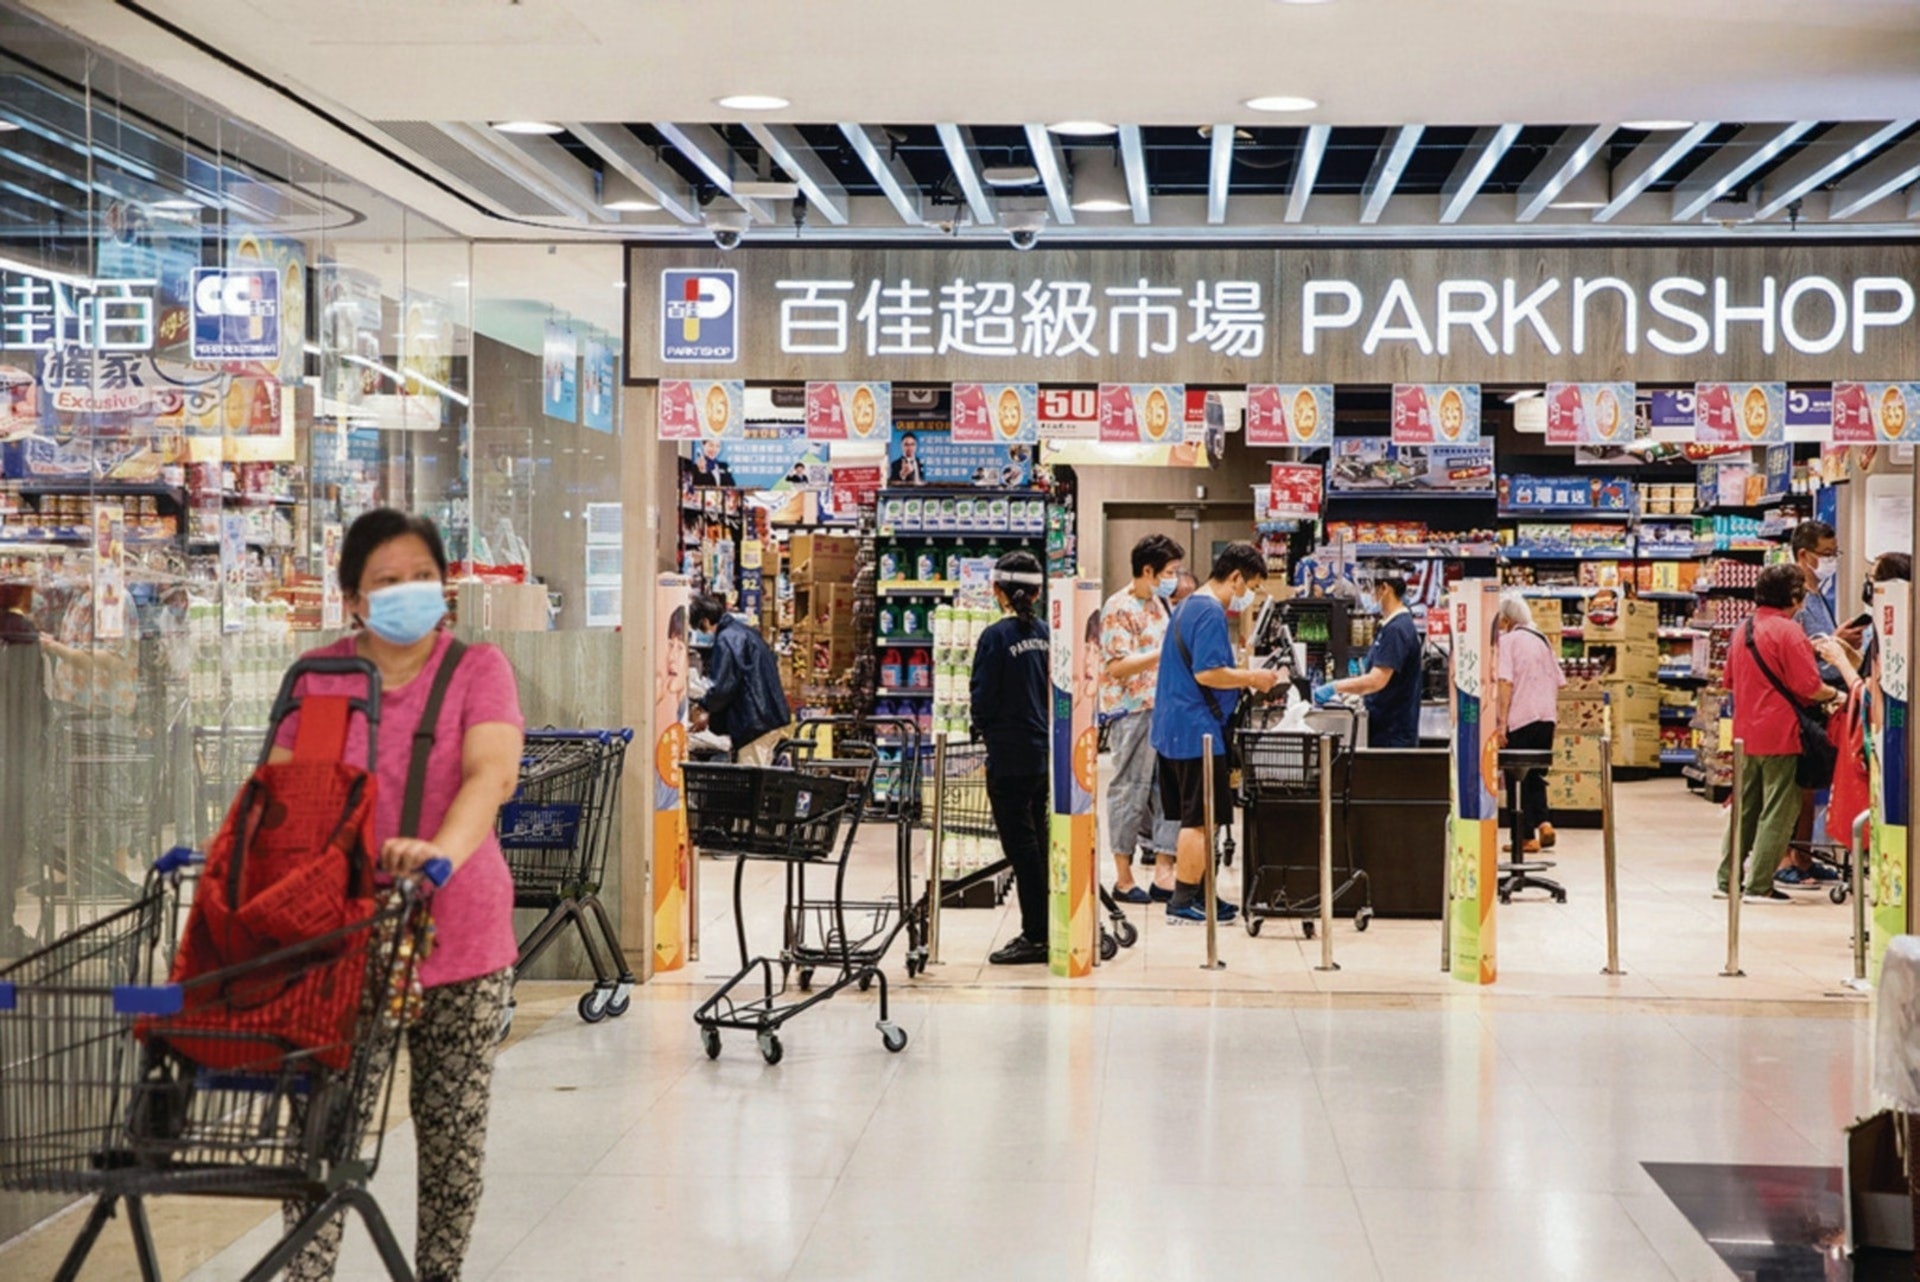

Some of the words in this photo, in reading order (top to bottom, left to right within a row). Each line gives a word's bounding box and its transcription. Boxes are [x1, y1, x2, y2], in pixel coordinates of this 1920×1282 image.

[775, 277, 1266, 360] 百佳超級市場
[1302, 276, 1915, 356] PARKnSHOP
[1516, 486, 1585, 504] 台灣直送
